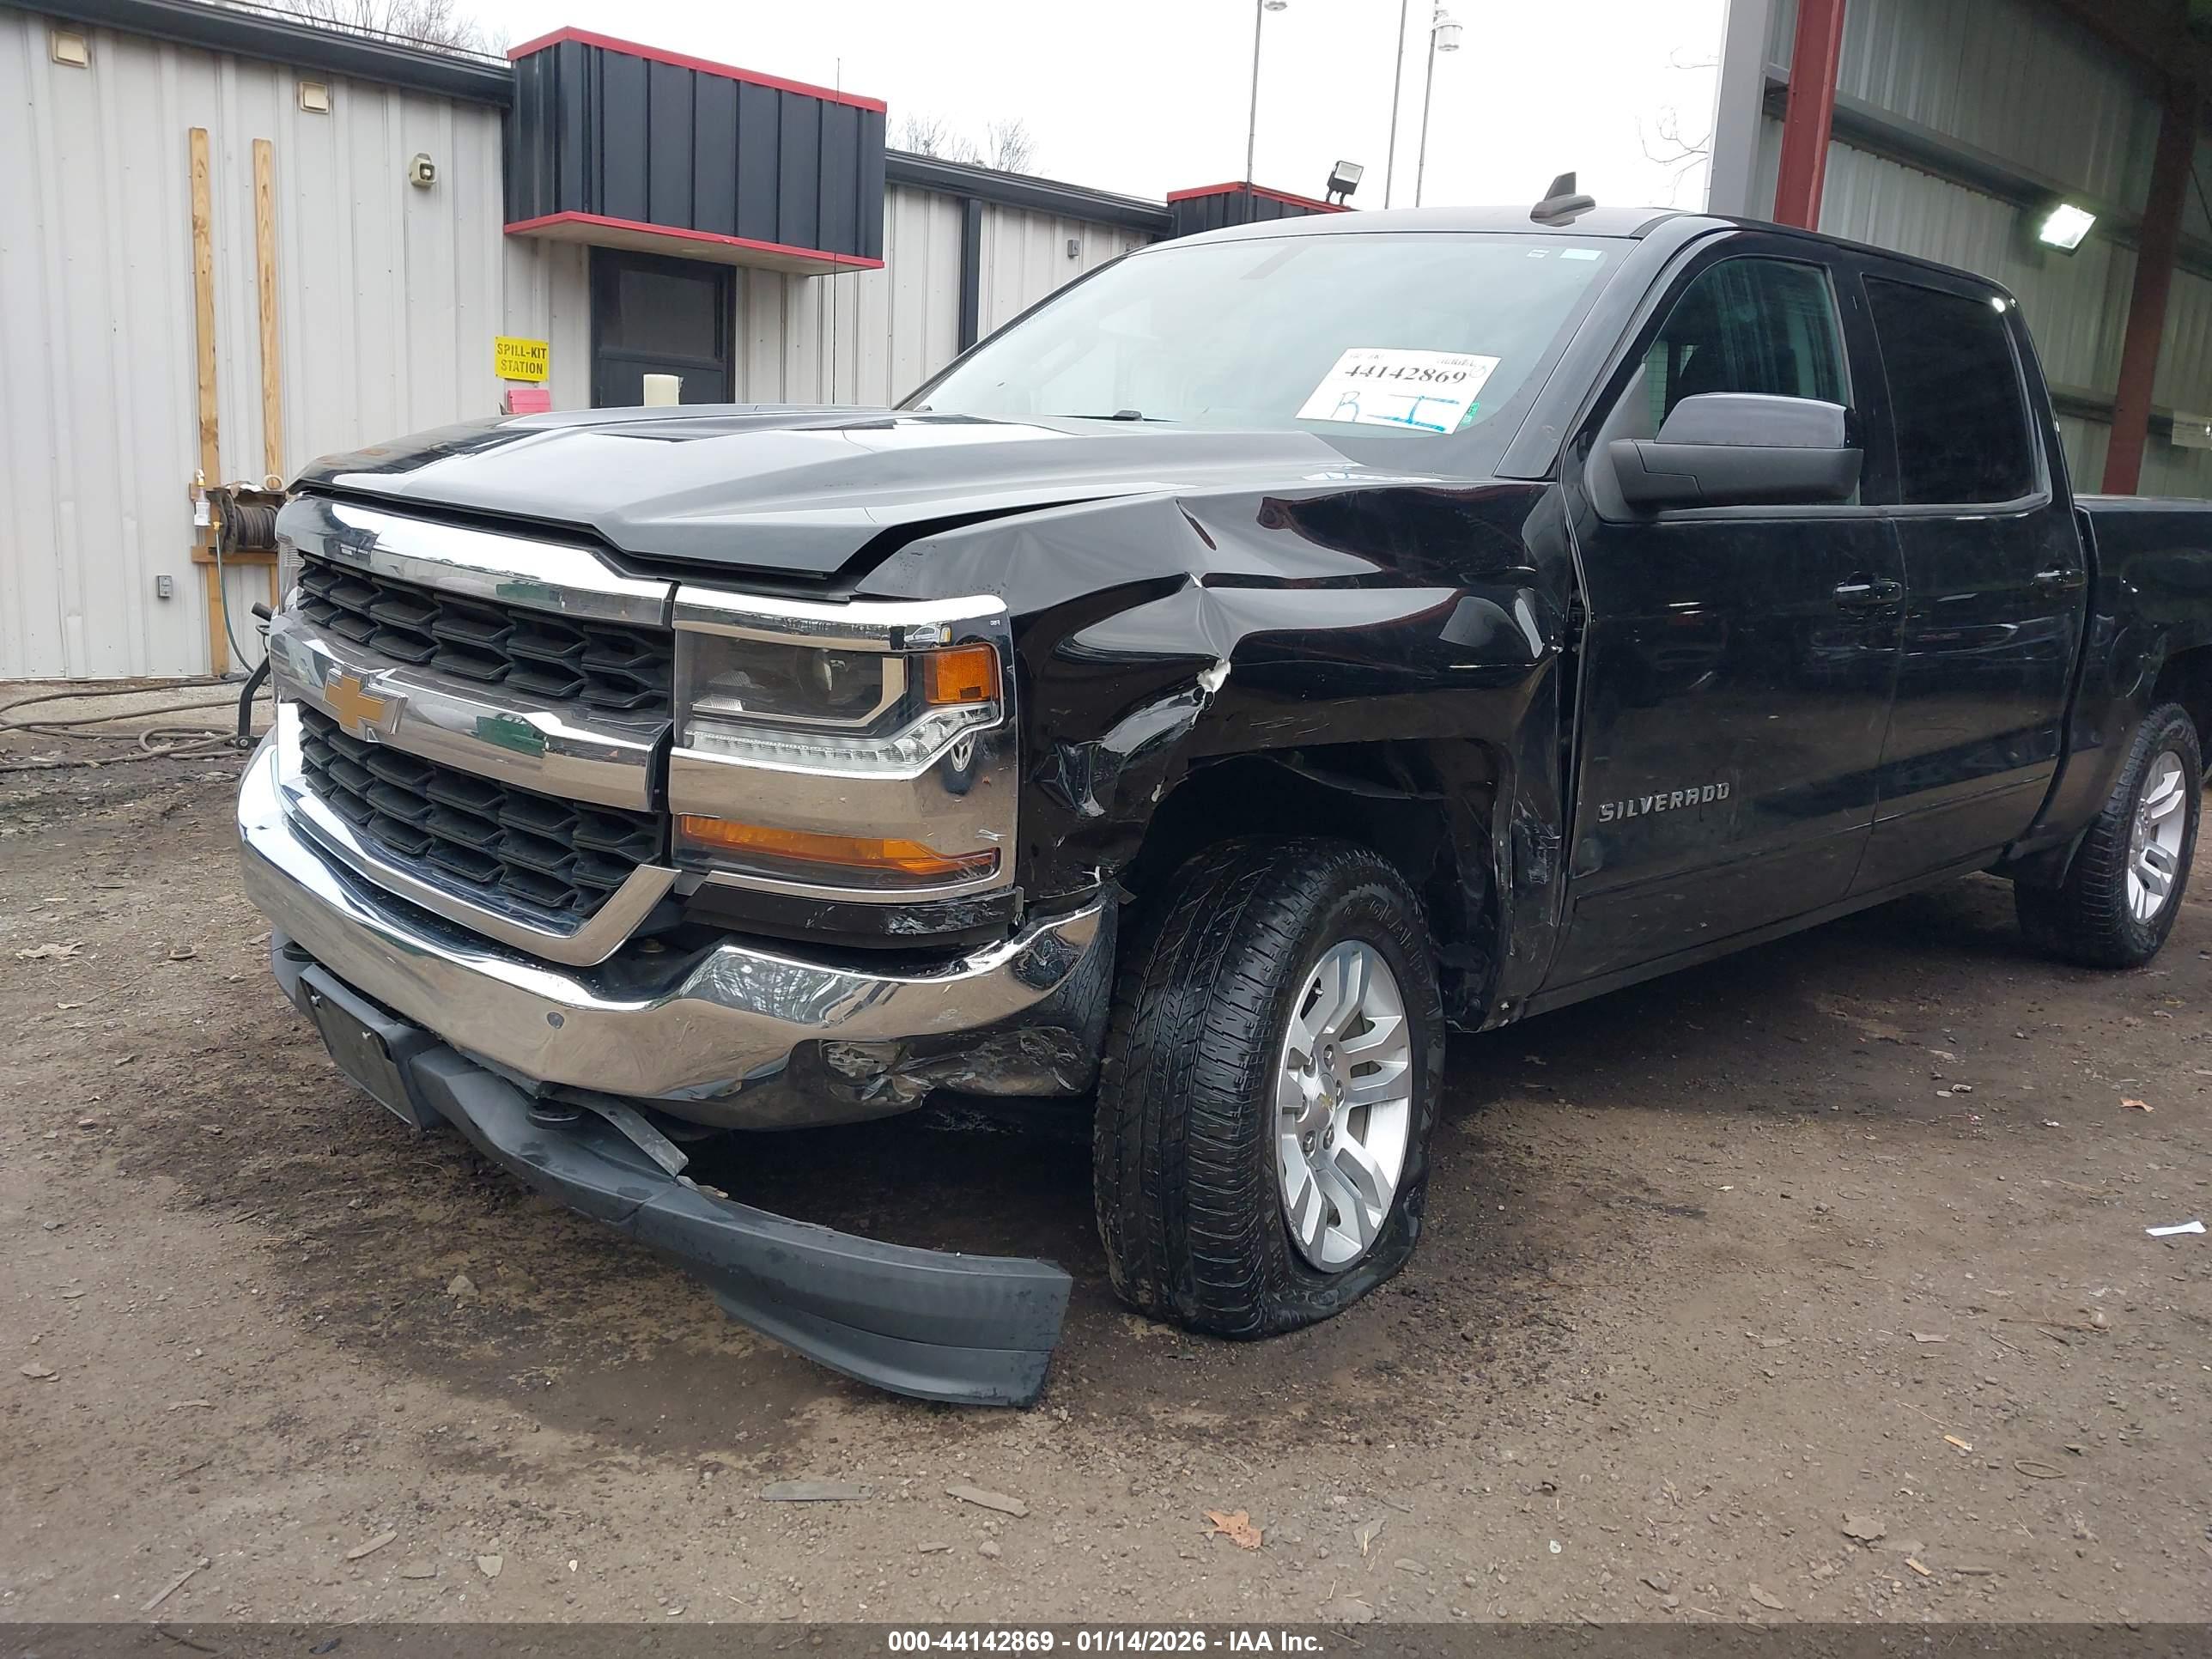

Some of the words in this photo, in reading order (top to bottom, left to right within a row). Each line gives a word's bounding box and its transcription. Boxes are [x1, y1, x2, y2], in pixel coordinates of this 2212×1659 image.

[497, 343, 547, 359] SPILL-KIT
[501, 359, 543, 374] STATION
[1345, 364, 1467, 384] 44142869
[1598, 782, 1730, 823] SILVERADO
